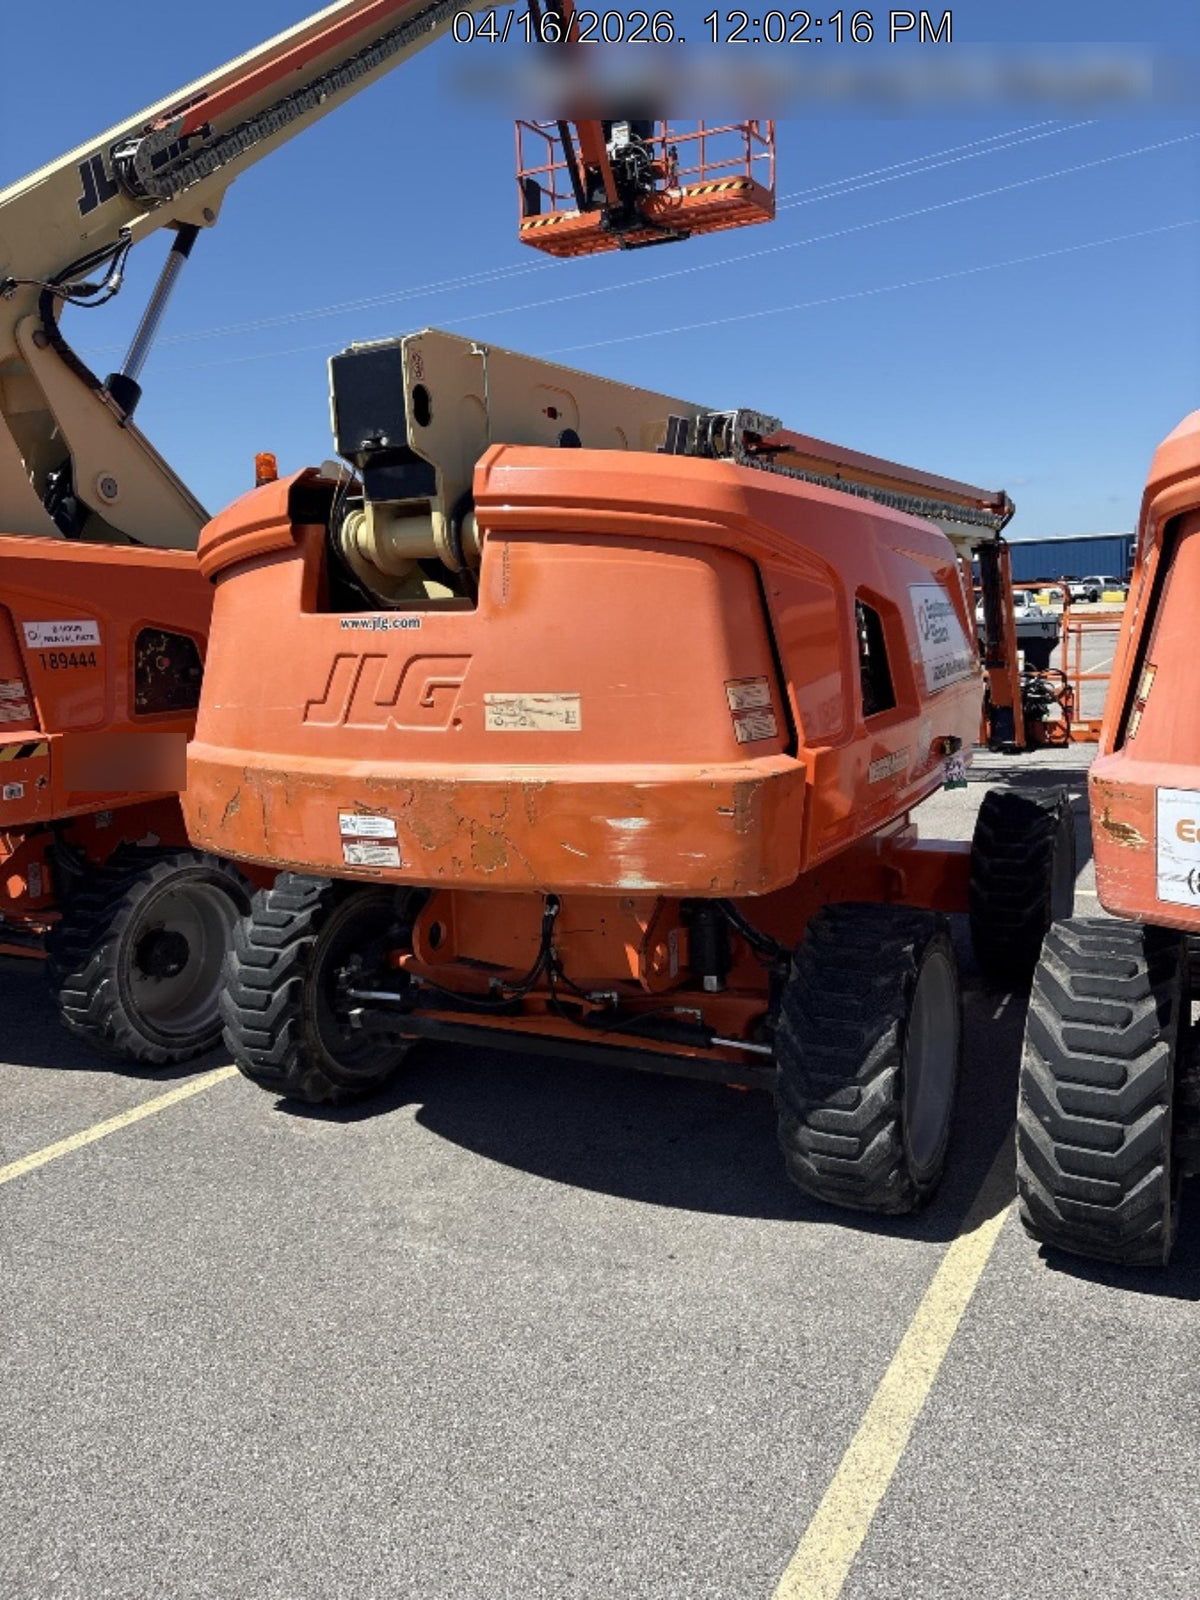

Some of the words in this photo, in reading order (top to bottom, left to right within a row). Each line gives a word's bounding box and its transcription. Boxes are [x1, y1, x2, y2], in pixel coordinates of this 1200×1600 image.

[340, 616, 421, 631] www.jlg.com
[39, 651, 97, 670] 189444
[302, 653, 473, 731] JLG
